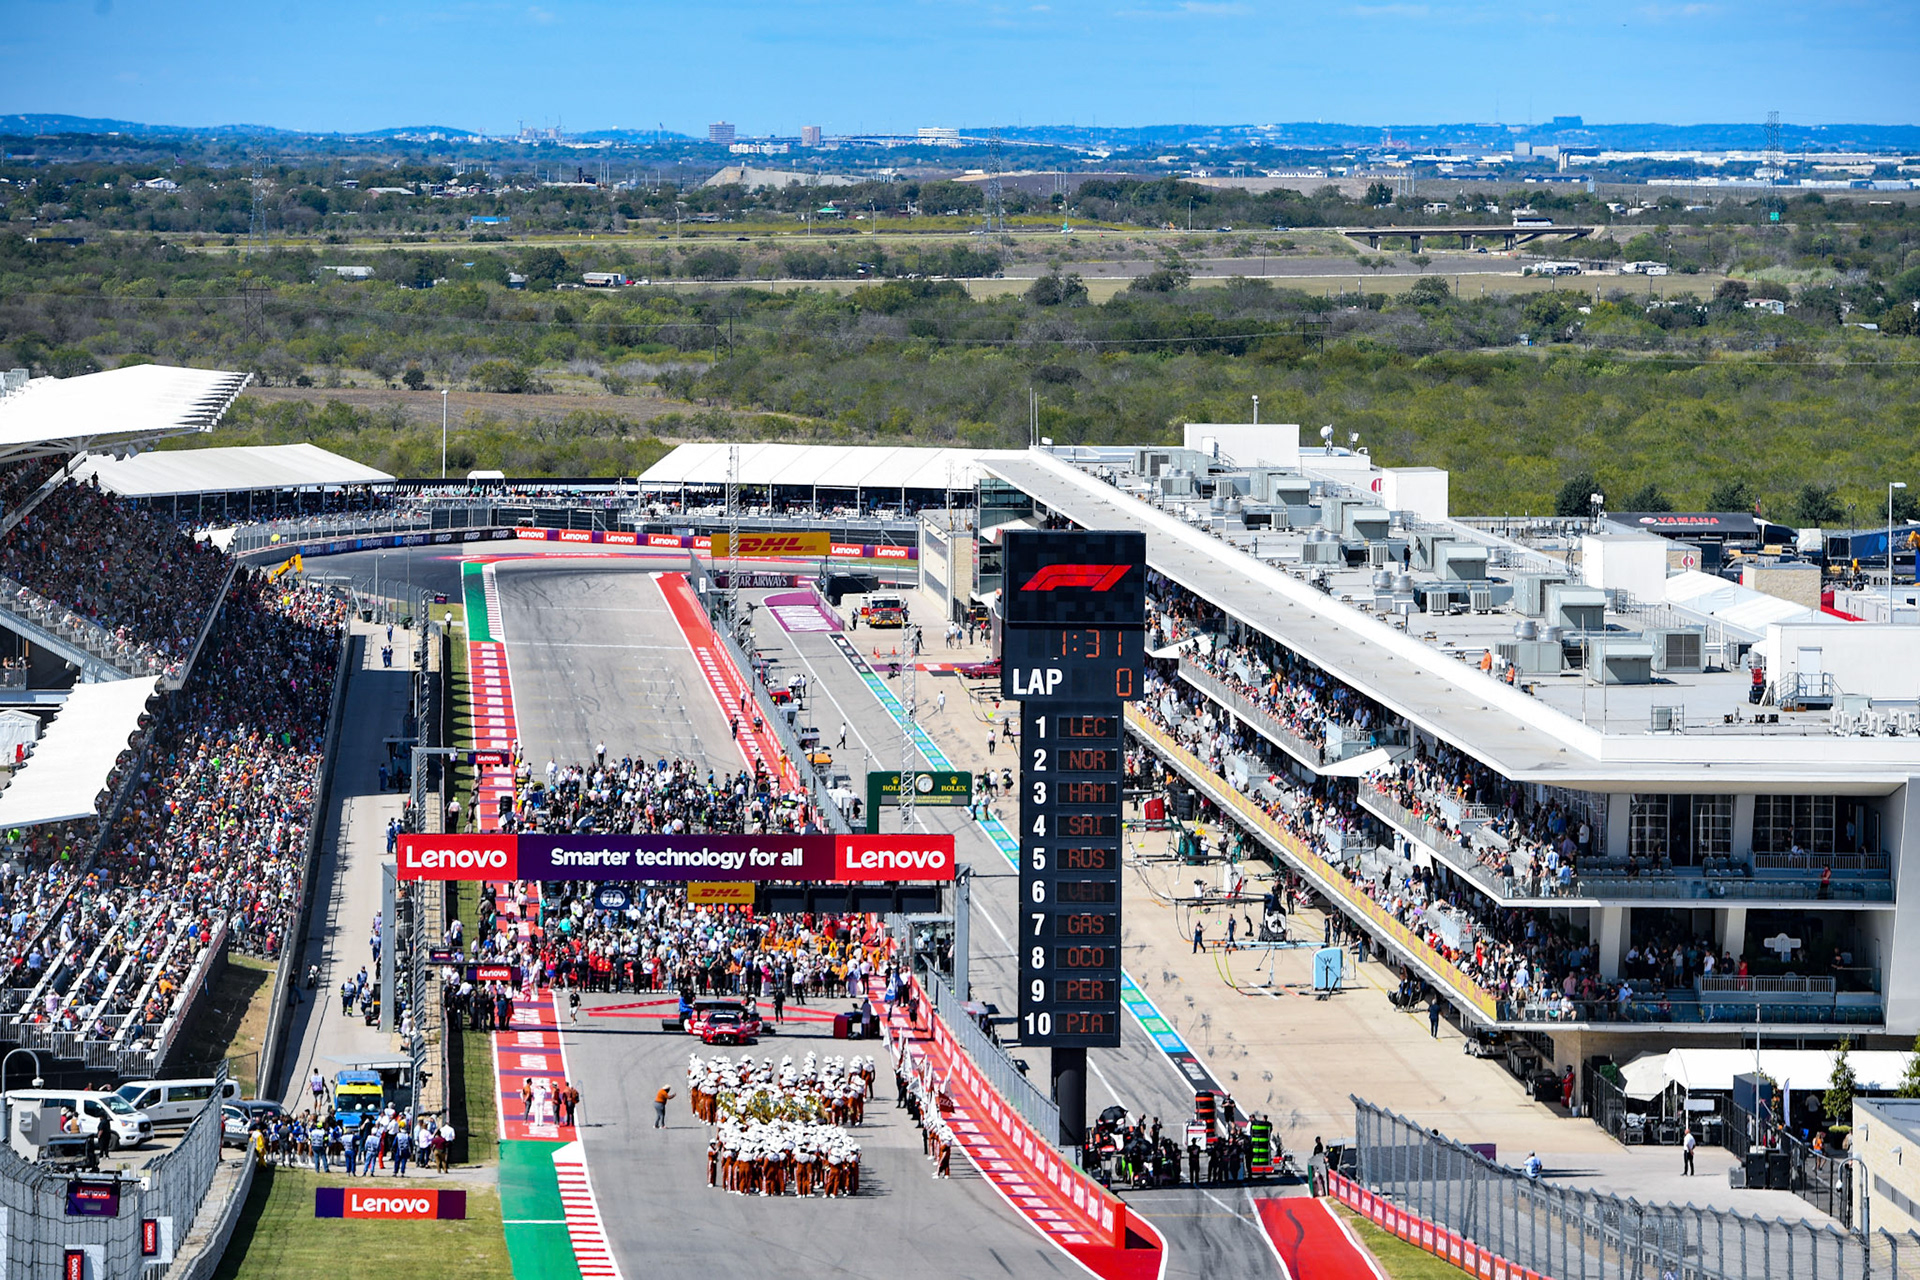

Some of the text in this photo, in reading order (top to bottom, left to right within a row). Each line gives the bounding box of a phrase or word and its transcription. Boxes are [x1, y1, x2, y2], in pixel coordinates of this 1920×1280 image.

[1657, 516, 1720, 524] YAMAHA
[516, 530, 545, 539] Lenovo
[561, 532, 590, 541] Lenovo
[605, 533, 635, 543] Lenovo
[650, 535, 679, 545] Lenovo
[696, 538, 711, 547] Len
[738, 538, 802, 553] DHL
[831, 546, 860, 555] Lenovo
[877, 547, 906, 557] Lenovo
[752, 575, 788, 587] AIRWAYS
[1013, 668, 1132, 697] LAP 0
[1035, 716, 1107, 738] 1 LEC
[1033, 748, 1106, 771] 2 NOR
[1033, 782, 1106, 804] 3 HAM
[1033, 814, 1103, 837] 4 SAI
[406, 845, 508, 868] Lenovo
[551, 848, 803, 870] Smarter technology for all
[846, 846, 946, 869] Lenovo
[1032, 847, 1105, 870] 5 RUS
[601, 892, 624, 904] FIA
[700, 888, 743, 898] DHL
[1031, 880, 1045, 903] 6
[1031, 913, 1105, 936] 7 GAS
[1031, 946, 1045, 969] 8
[479, 969, 508, 977] Lenovo
[1031, 979, 1104, 1002] 9 PER
[1024, 1012, 1103, 1035] 10 PIA
[80, 1188, 108, 1197] Lenovo
[351, 1194, 430, 1213] Lenovo
